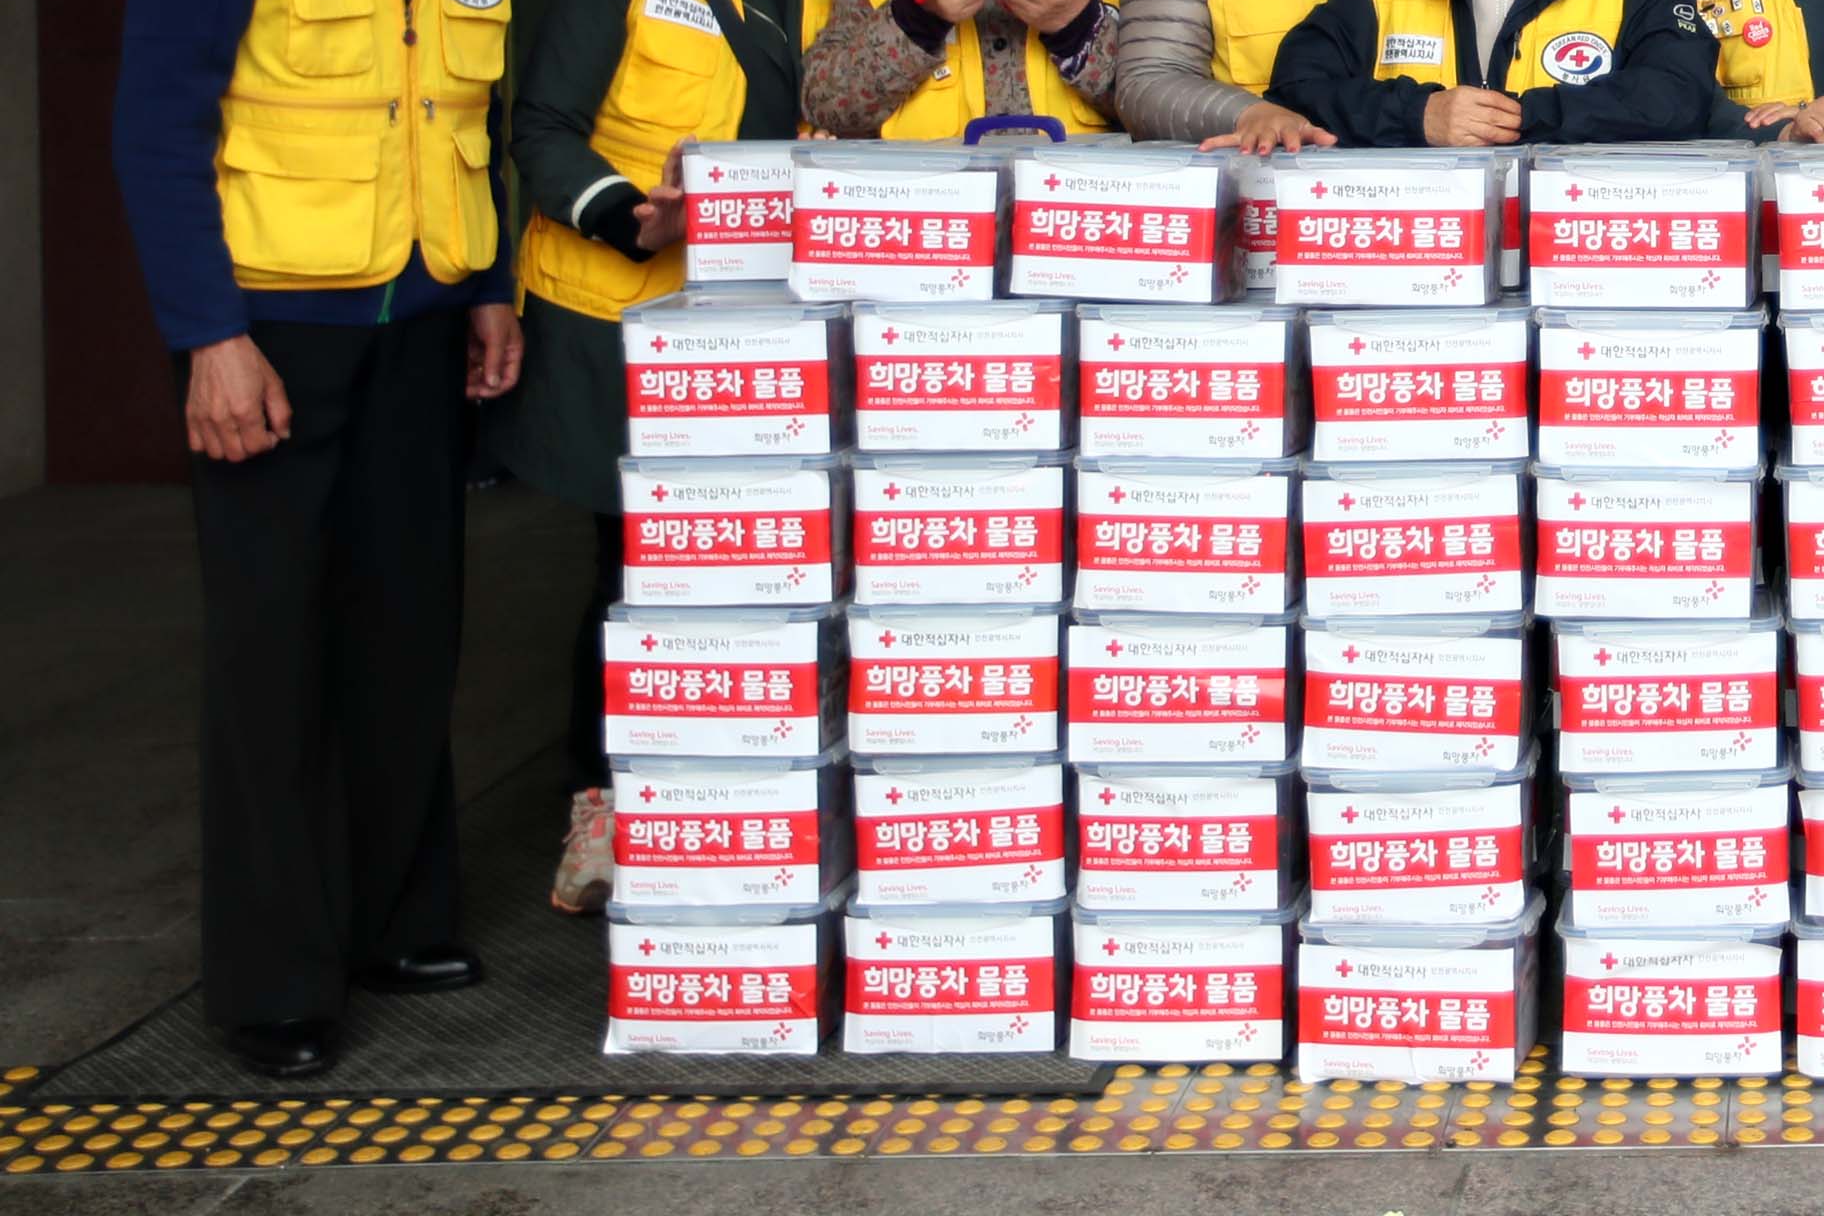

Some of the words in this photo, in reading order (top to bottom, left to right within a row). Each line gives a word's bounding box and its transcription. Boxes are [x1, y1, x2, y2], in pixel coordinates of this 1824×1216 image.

[843, 185, 910, 200] 대한적십자사
[1332, 184, 1401, 199] 대한적십자사
[697, 197, 794, 228] 희망풍차
[1029, 206, 1133, 243] 희망풍차
[1140, 212, 1191, 245] 물품
[809, 214, 912, 248] 희망풍차
[920, 218, 971, 250] 물품
[1297, 215, 1404, 248] 희망풍차
[1411, 217, 1463, 248] 물품
[1553, 218, 1661, 250] 희망풍차
[1668, 219, 1721, 250] 물품
[672, 337, 740, 352] 대한적십자사
[638, 368, 745, 401] 희망풍차
[751, 368, 804, 399] 물품
[868, 361, 975, 393] 희망풍차
[983, 362, 1035, 393] 물품
[1094, 367, 1201, 400] 희망풍차
[1208, 369, 1260, 401] 물품
[1336, 370, 1445, 404] 희망풍차
[1452, 369, 1505, 402] 물품
[1564, 376, 1674, 409] 희망풍차
[1682, 378, 1735, 409] 물품
[905, 485, 974, 500] 대한적십자사
[1591, 496, 1661, 510] 대한적십자사
[639, 517, 746, 550] 희망풍차
[752, 517, 805, 548] 물품
[870, 516, 978, 549] 희망풍차
[985, 516, 1037, 547] 물품
[1094, 520, 1202, 555] 희망풍차
[1209, 524, 1262, 556] 물품
[1326, 524, 1435, 560] 희망풍차
[1441, 523, 1495, 556] 물품
[1555, 527, 1664, 560] 희망풍차
[1672, 529, 1725, 561] 물품
[662, 638, 730, 652] 대한적십자사
[628, 668, 733, 700] 희망풍차
[741, 670, 792, 701] 물품
[866, 664, 973, 697] 희망풍차
[981, 665, 1033, 696] 물품
[1092, 674, 1200, 706] 희망풍차
[1207, 675, 1260, 706] 물품
[1328, 679, 1436, 716] 희망풍차
[1443, 685, 1496, 718] 물품
[1581, 681, 1691, 715] 희망풍차
[1699, 681, 1753, 713] 물품
[627, 818, 733, 850] 희망풍차
[740, 819, 792, 850] 물품
[874, 816, 982, 854] 희망풍차
[987, 814, 1041, 848] 물품
[1086, 822, 1192, 854] 희망풍차
[1200, 823, 1251, 854] 물품
[1329, 837, 1439, 873] 희망풍차
[1445, 835, 1500, 869] 물품
[1596, 838, 1706, 874] 희망풍차
[1713, 837, 1767, 870] 물품
[897, 934, 965, 949] 대한적십자사
[626, 972, 732, 1003] 희망풍차
[739, 974, 792, 1004] 물품
[862, 965, 969, 998] 희망풍차
[976, 965, 1028, 997] 물품
[1089, 972, 1197, 1005] 희망풍차
[1205, 973, 1257, 1004] 물품
[1323, 994, 1430, 1030] 희망풍차
[1437, 999, 1490, 1031] 물품
[1587, 985, 1697, 1017] 희망풍차
[1704, 986, 1758, 1017] 물품
